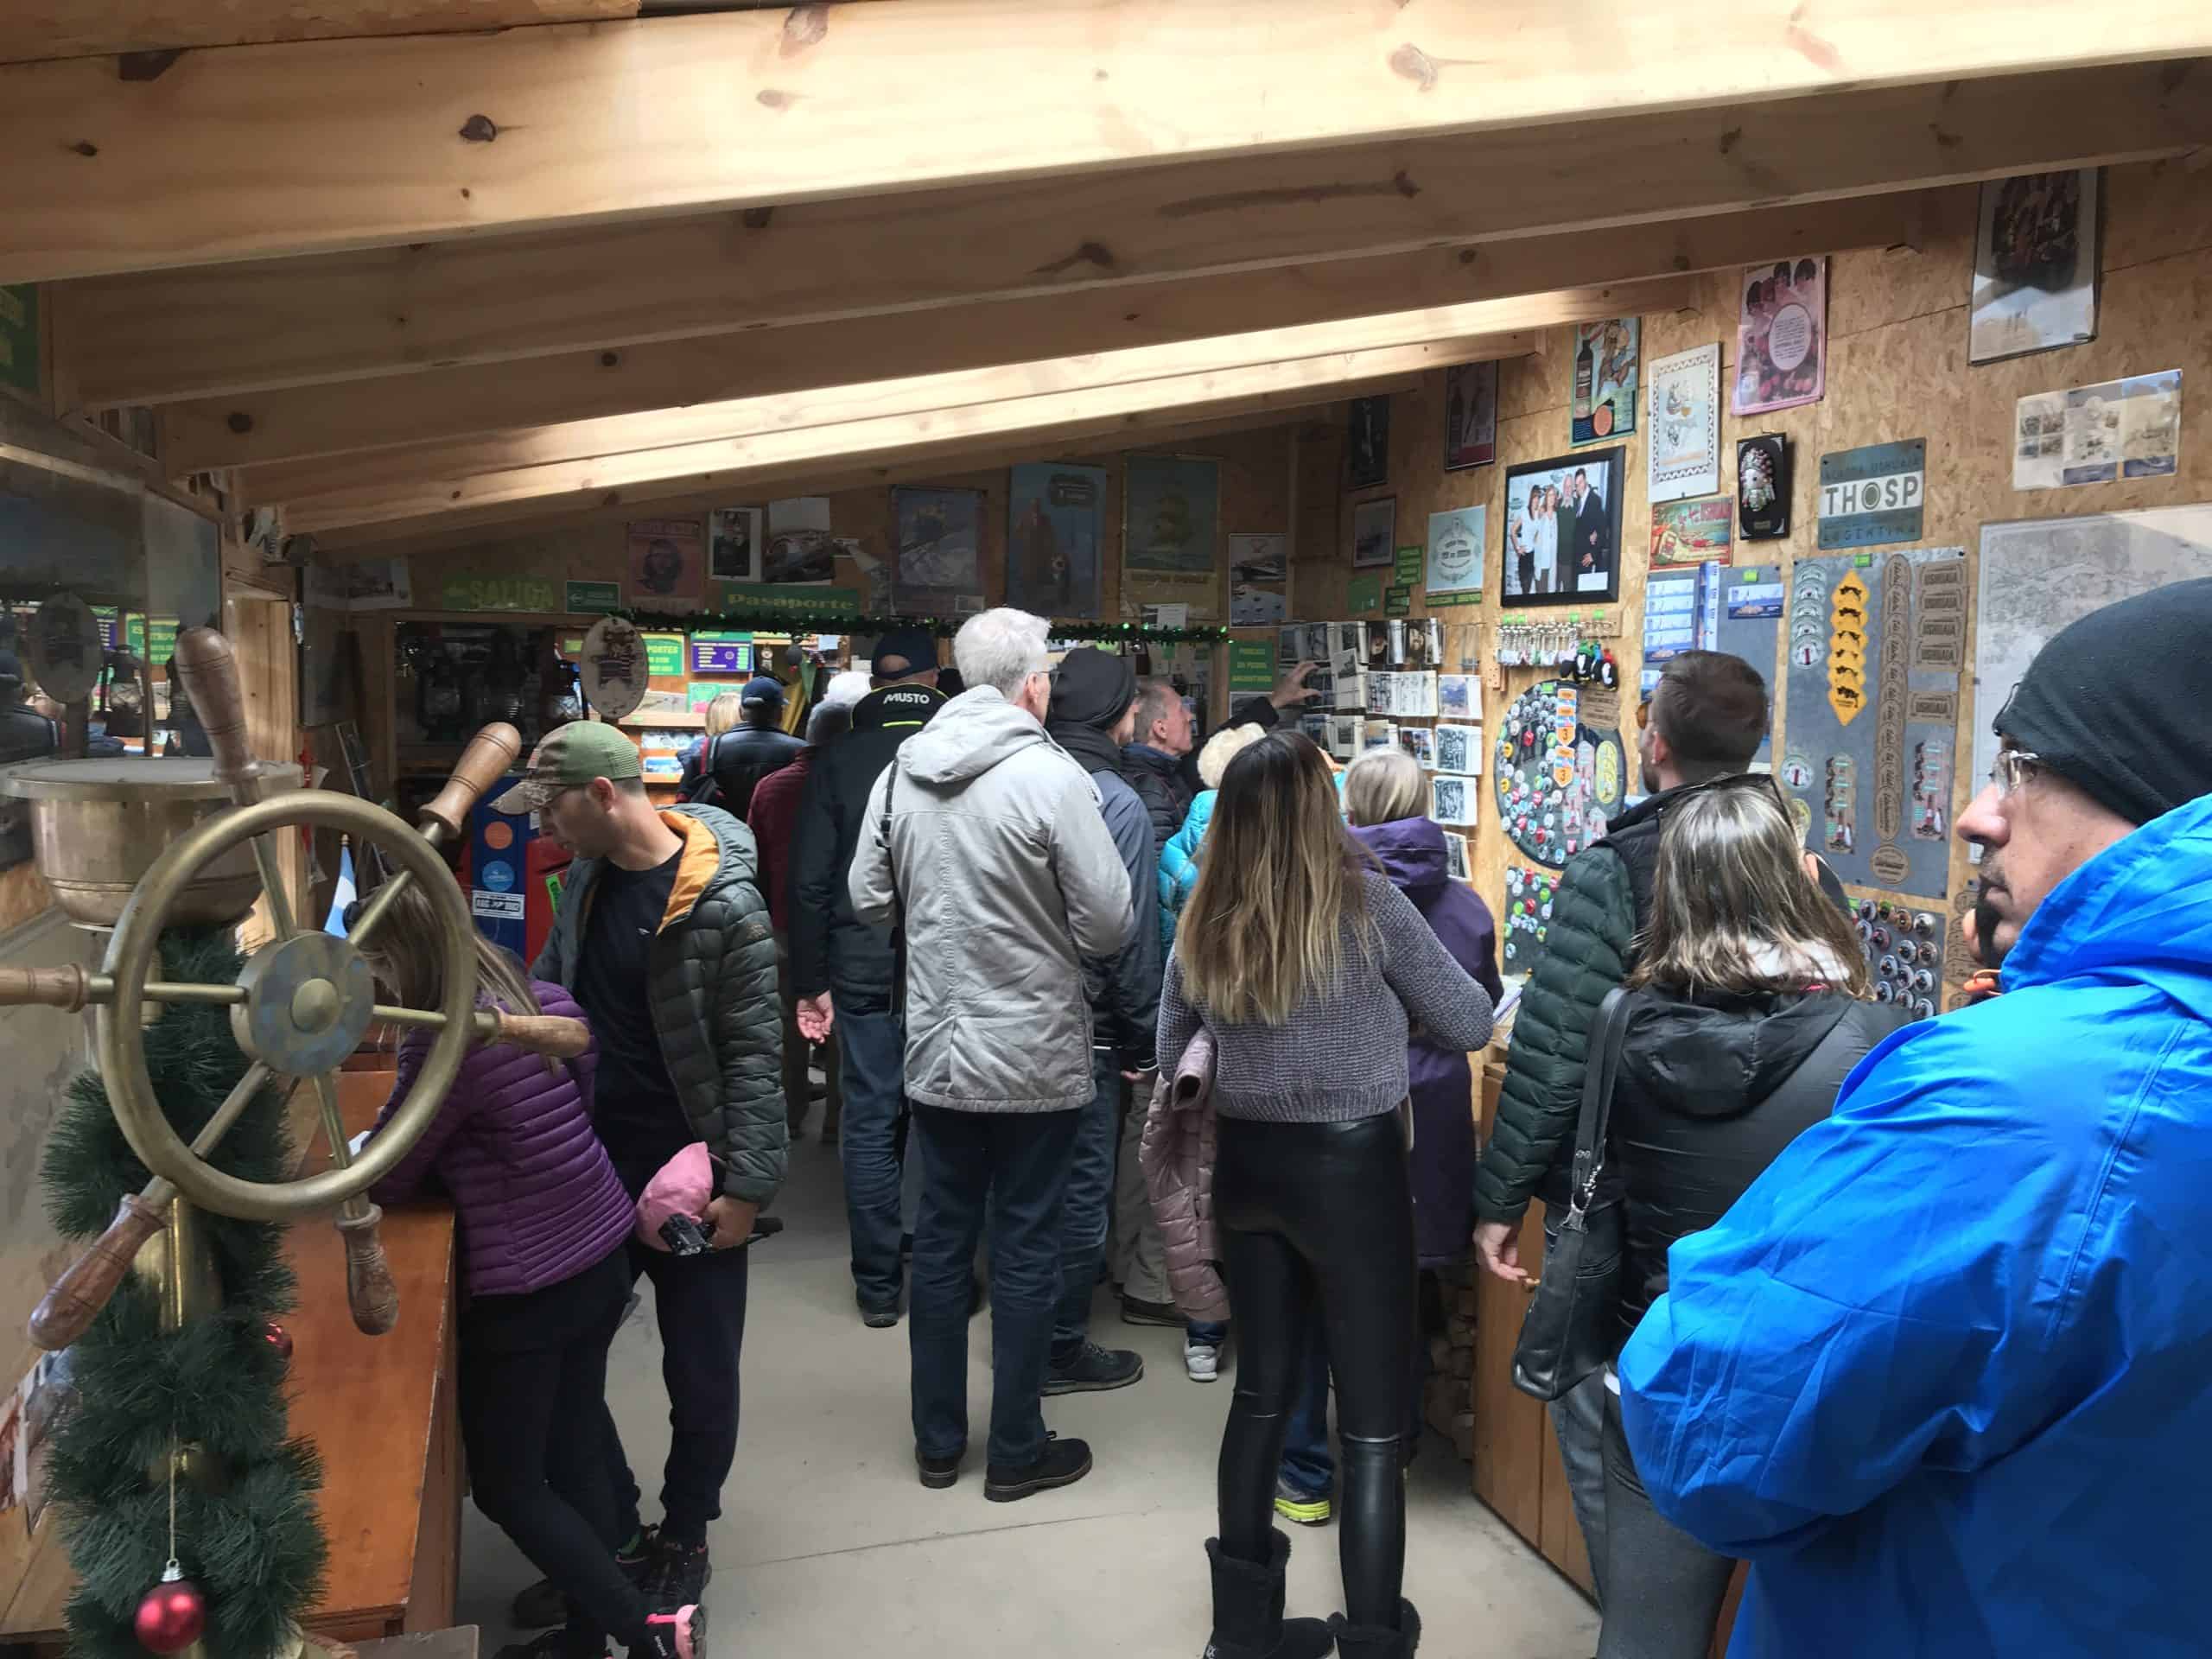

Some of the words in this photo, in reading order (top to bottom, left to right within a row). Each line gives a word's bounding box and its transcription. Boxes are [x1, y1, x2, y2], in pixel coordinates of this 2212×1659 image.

[1825, 475, 1918, 516] THOSP
[470, 579, 554, 607] SALIDA
[728, 593, 855, 609] Pasaporte
[882, 692, 931, 705] MUSTO
